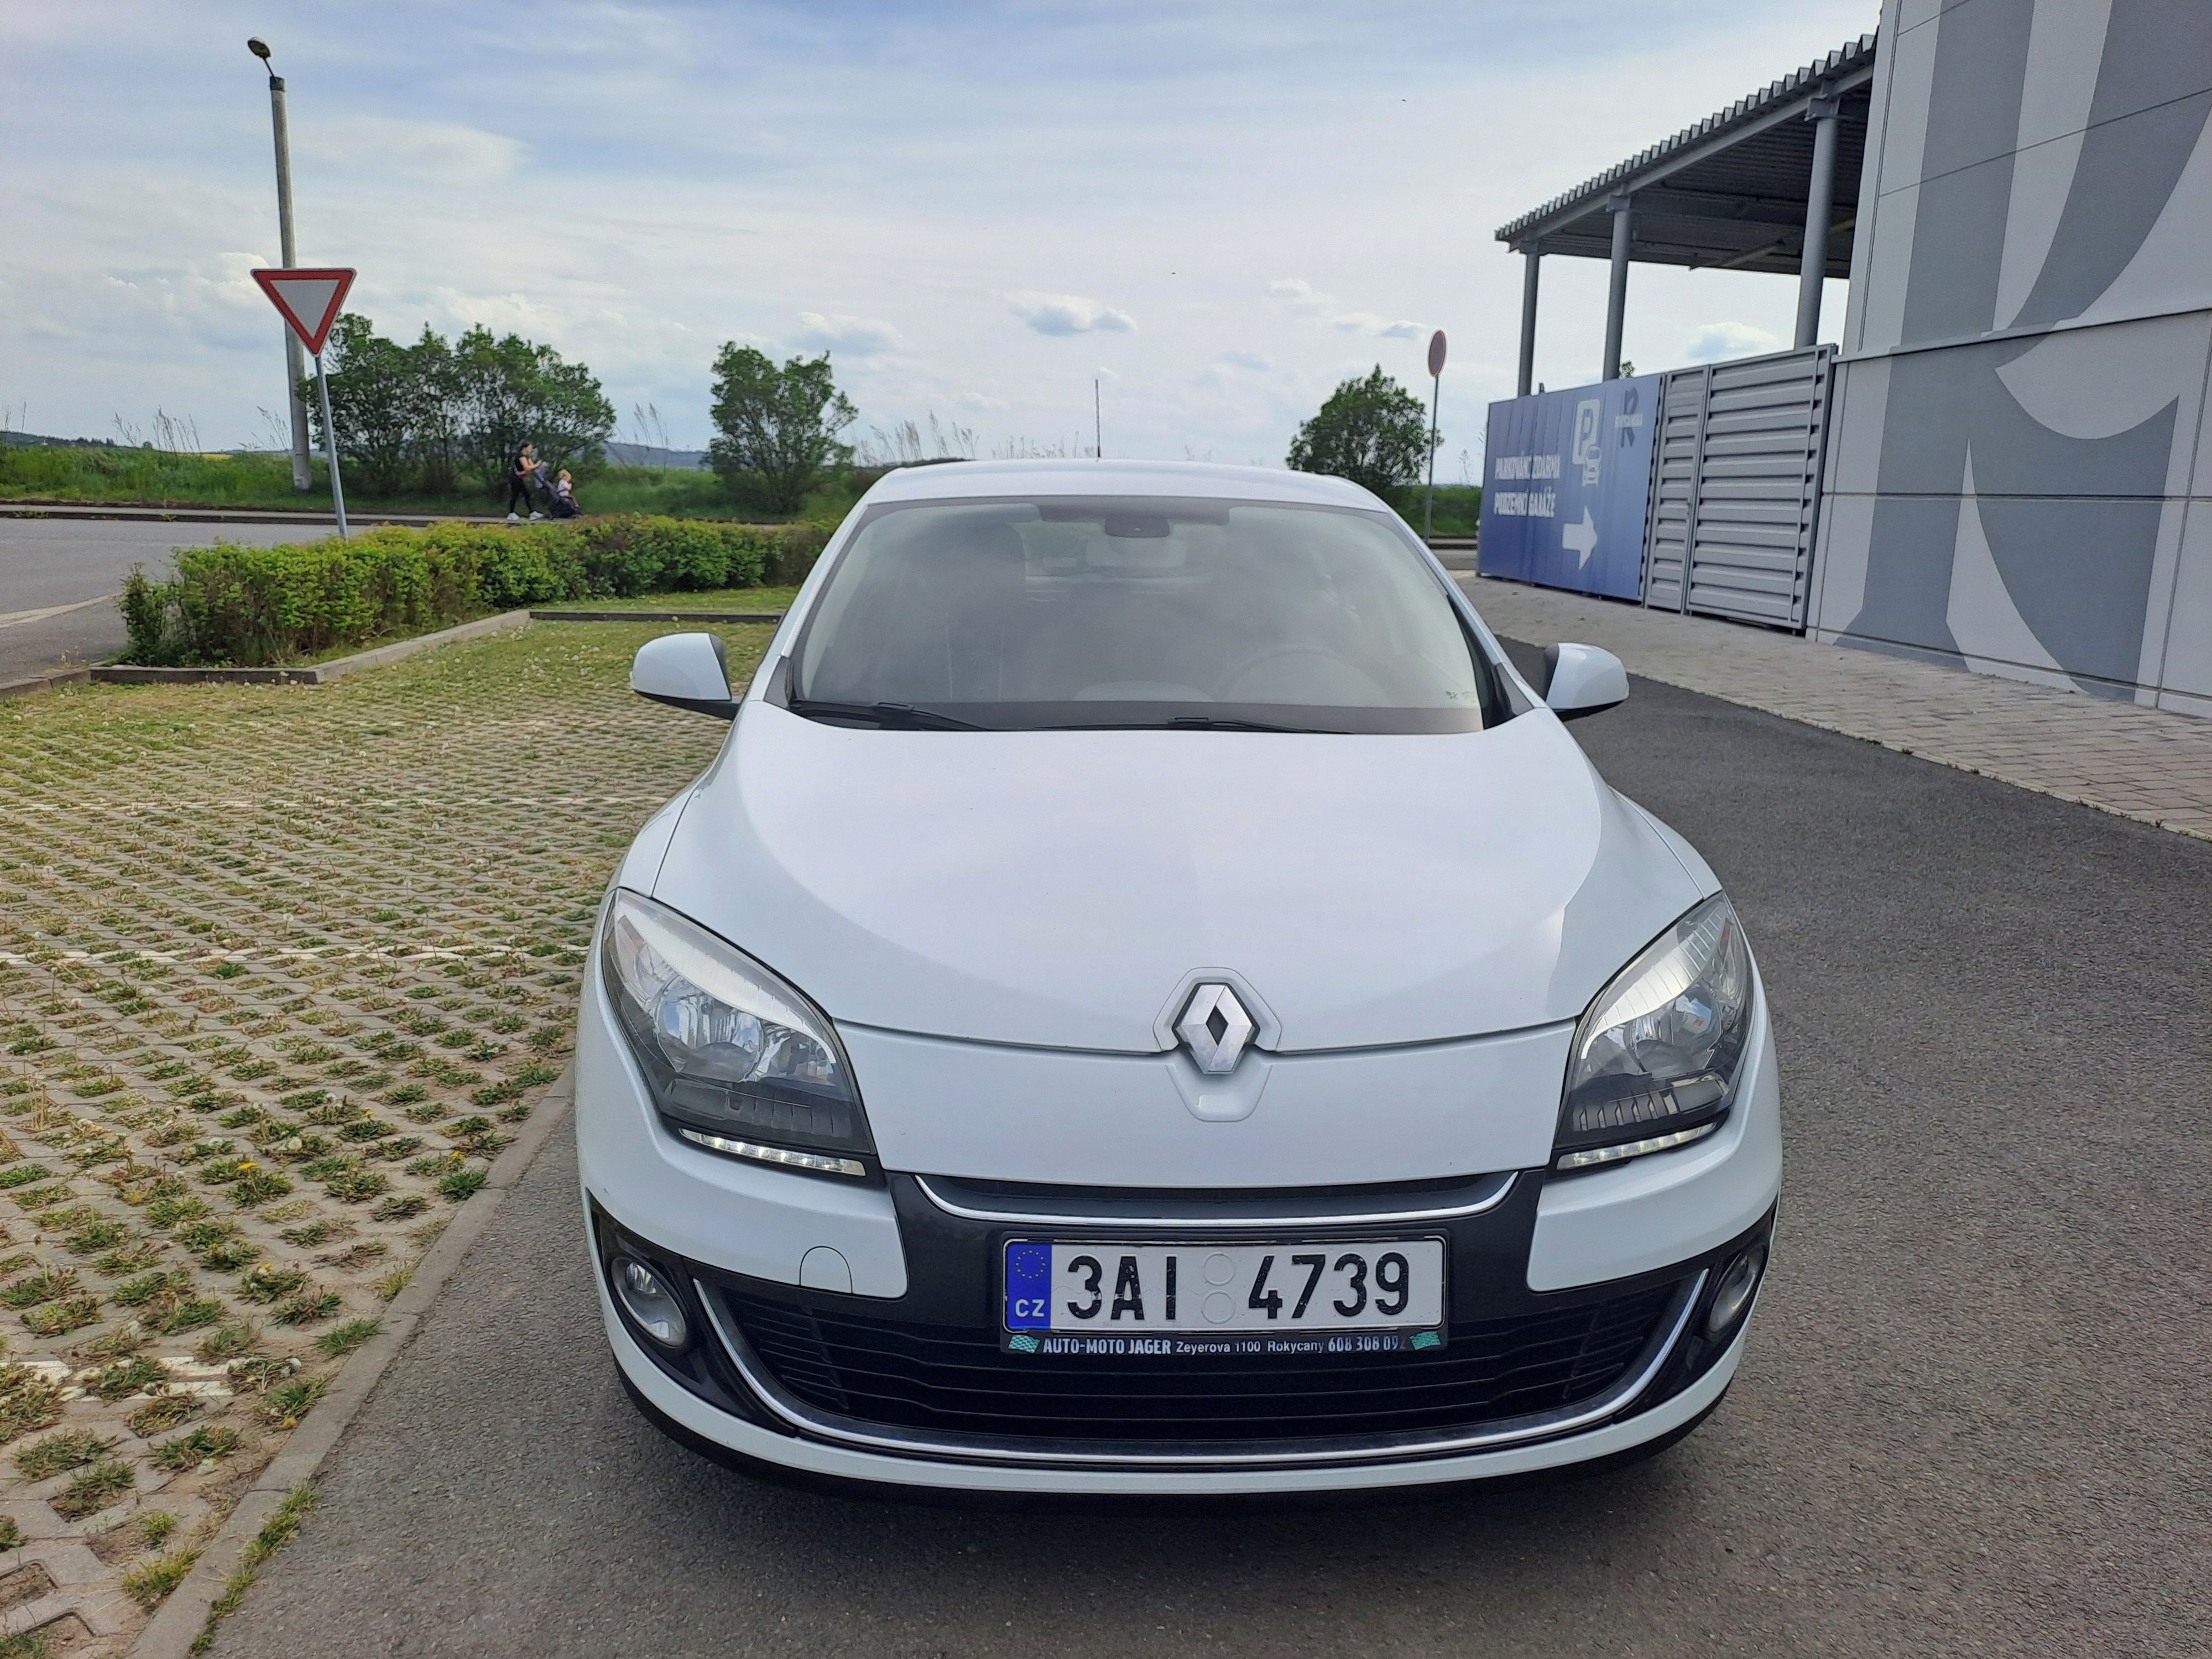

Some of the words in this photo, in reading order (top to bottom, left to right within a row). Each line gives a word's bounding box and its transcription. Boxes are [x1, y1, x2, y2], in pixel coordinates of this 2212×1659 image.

[1067, 1255, 1177, 1321] 3AI
[1248, 1252, 1409, 1319] 4739
[1015, 1299, 1045, 1318] CZ
[1042, 1338, 1125, 1354] AUTO-MOTO
[1128, 1339, 1172, 1354] JAGER
[1176, 1340, 1231, 1355] Zeyerova
[1235, 1340, 1261, 1353] 1100
[1267, 1340, 1324, 1354] Rokycany
[1328, 1335, 1353, 1352] 608
[1357, 1335, 1380, 1351] 308
